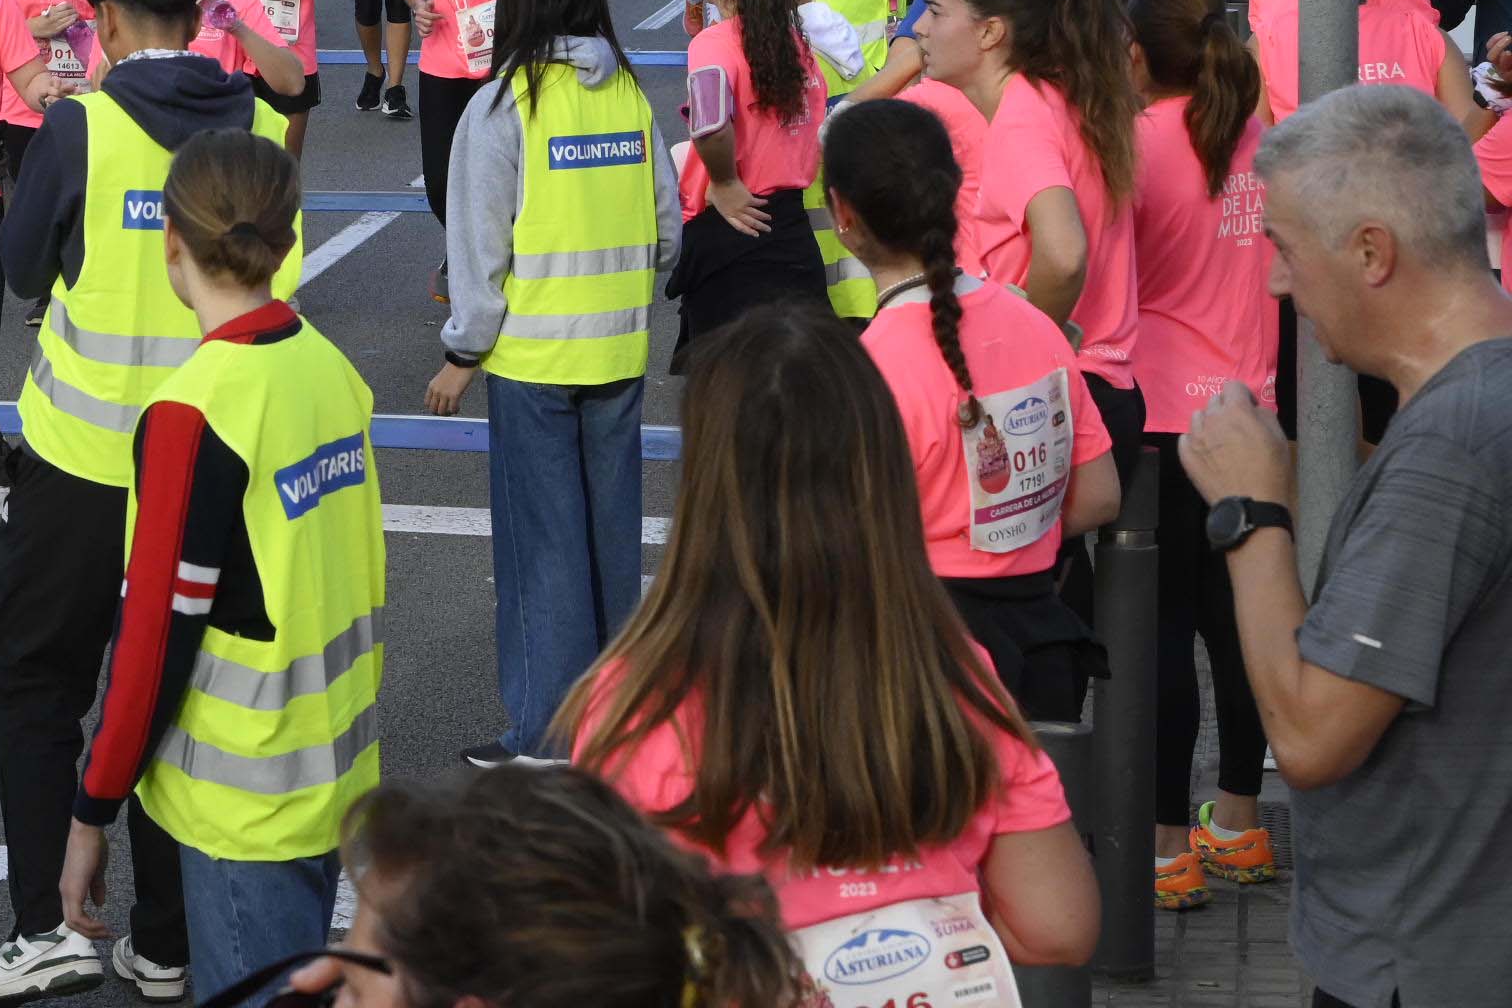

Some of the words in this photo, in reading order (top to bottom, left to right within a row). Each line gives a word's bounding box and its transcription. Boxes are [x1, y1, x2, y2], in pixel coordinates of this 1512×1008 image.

[54, 48, 73, 59] 01
[58, 62, 80, 70] 14613
[551, 140, 642, 162] VOLUNTARIS
[1222, 196, 1241, 216] DE
[1246, 193, 1264, 213] LA
[1013, 442, 1048, 473] 016
[989, 497, 1024, 519] CARRERA
[988, 522, 1027, 544] OYSHO
[839, 881, 878, 898] 2023
[934, 920, 977, 939] SUMA
[834, 945, 925, 980] ASTURIANA
